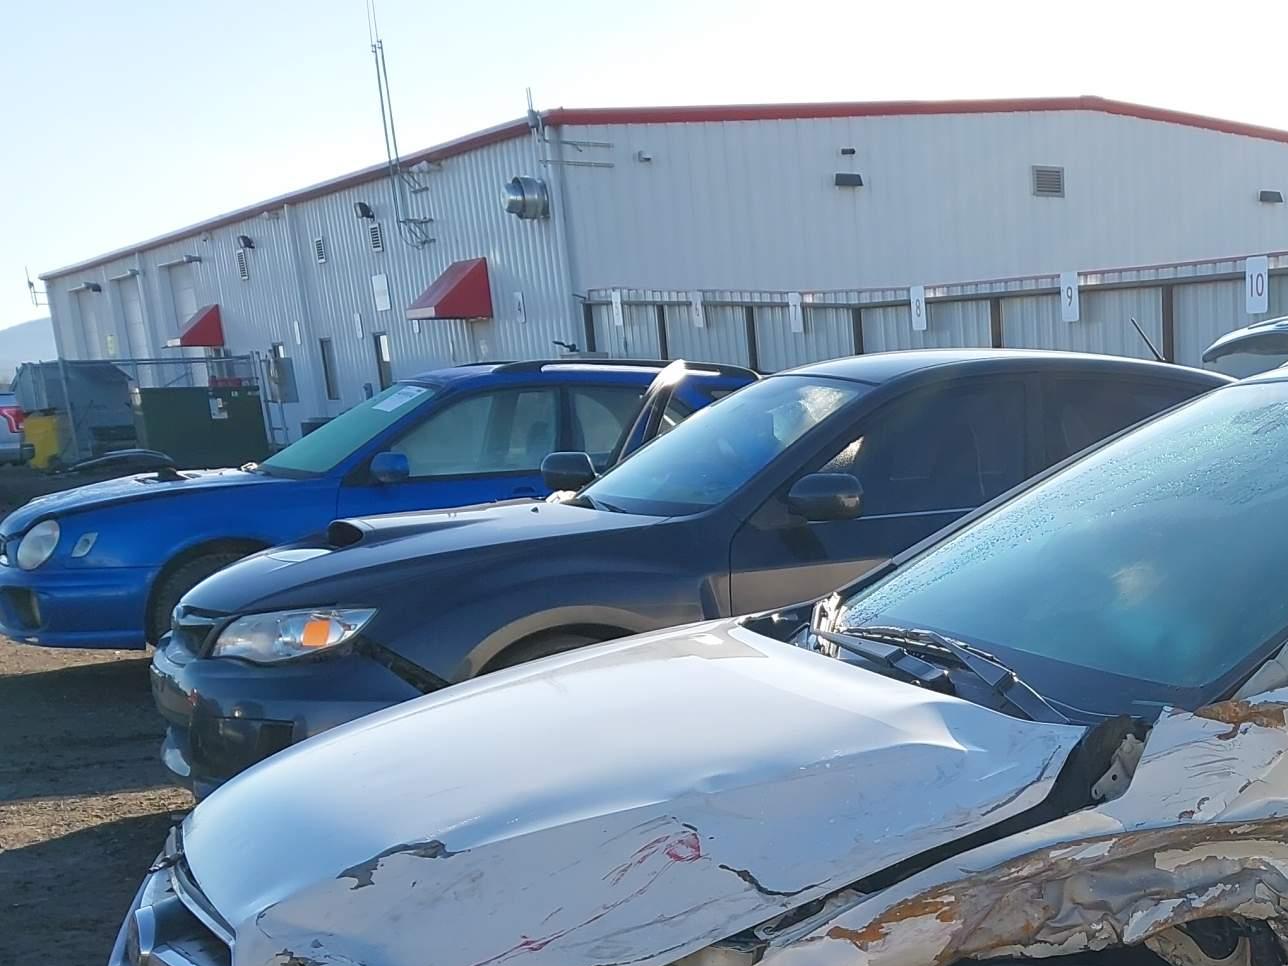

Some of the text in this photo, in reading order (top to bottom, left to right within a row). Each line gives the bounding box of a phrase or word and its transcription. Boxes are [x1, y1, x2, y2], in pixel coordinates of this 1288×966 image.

[1249, 273, 1264, 297] 10
[1066, 286, 1073, 306] 9
[915, 298, 922, 317] 8
